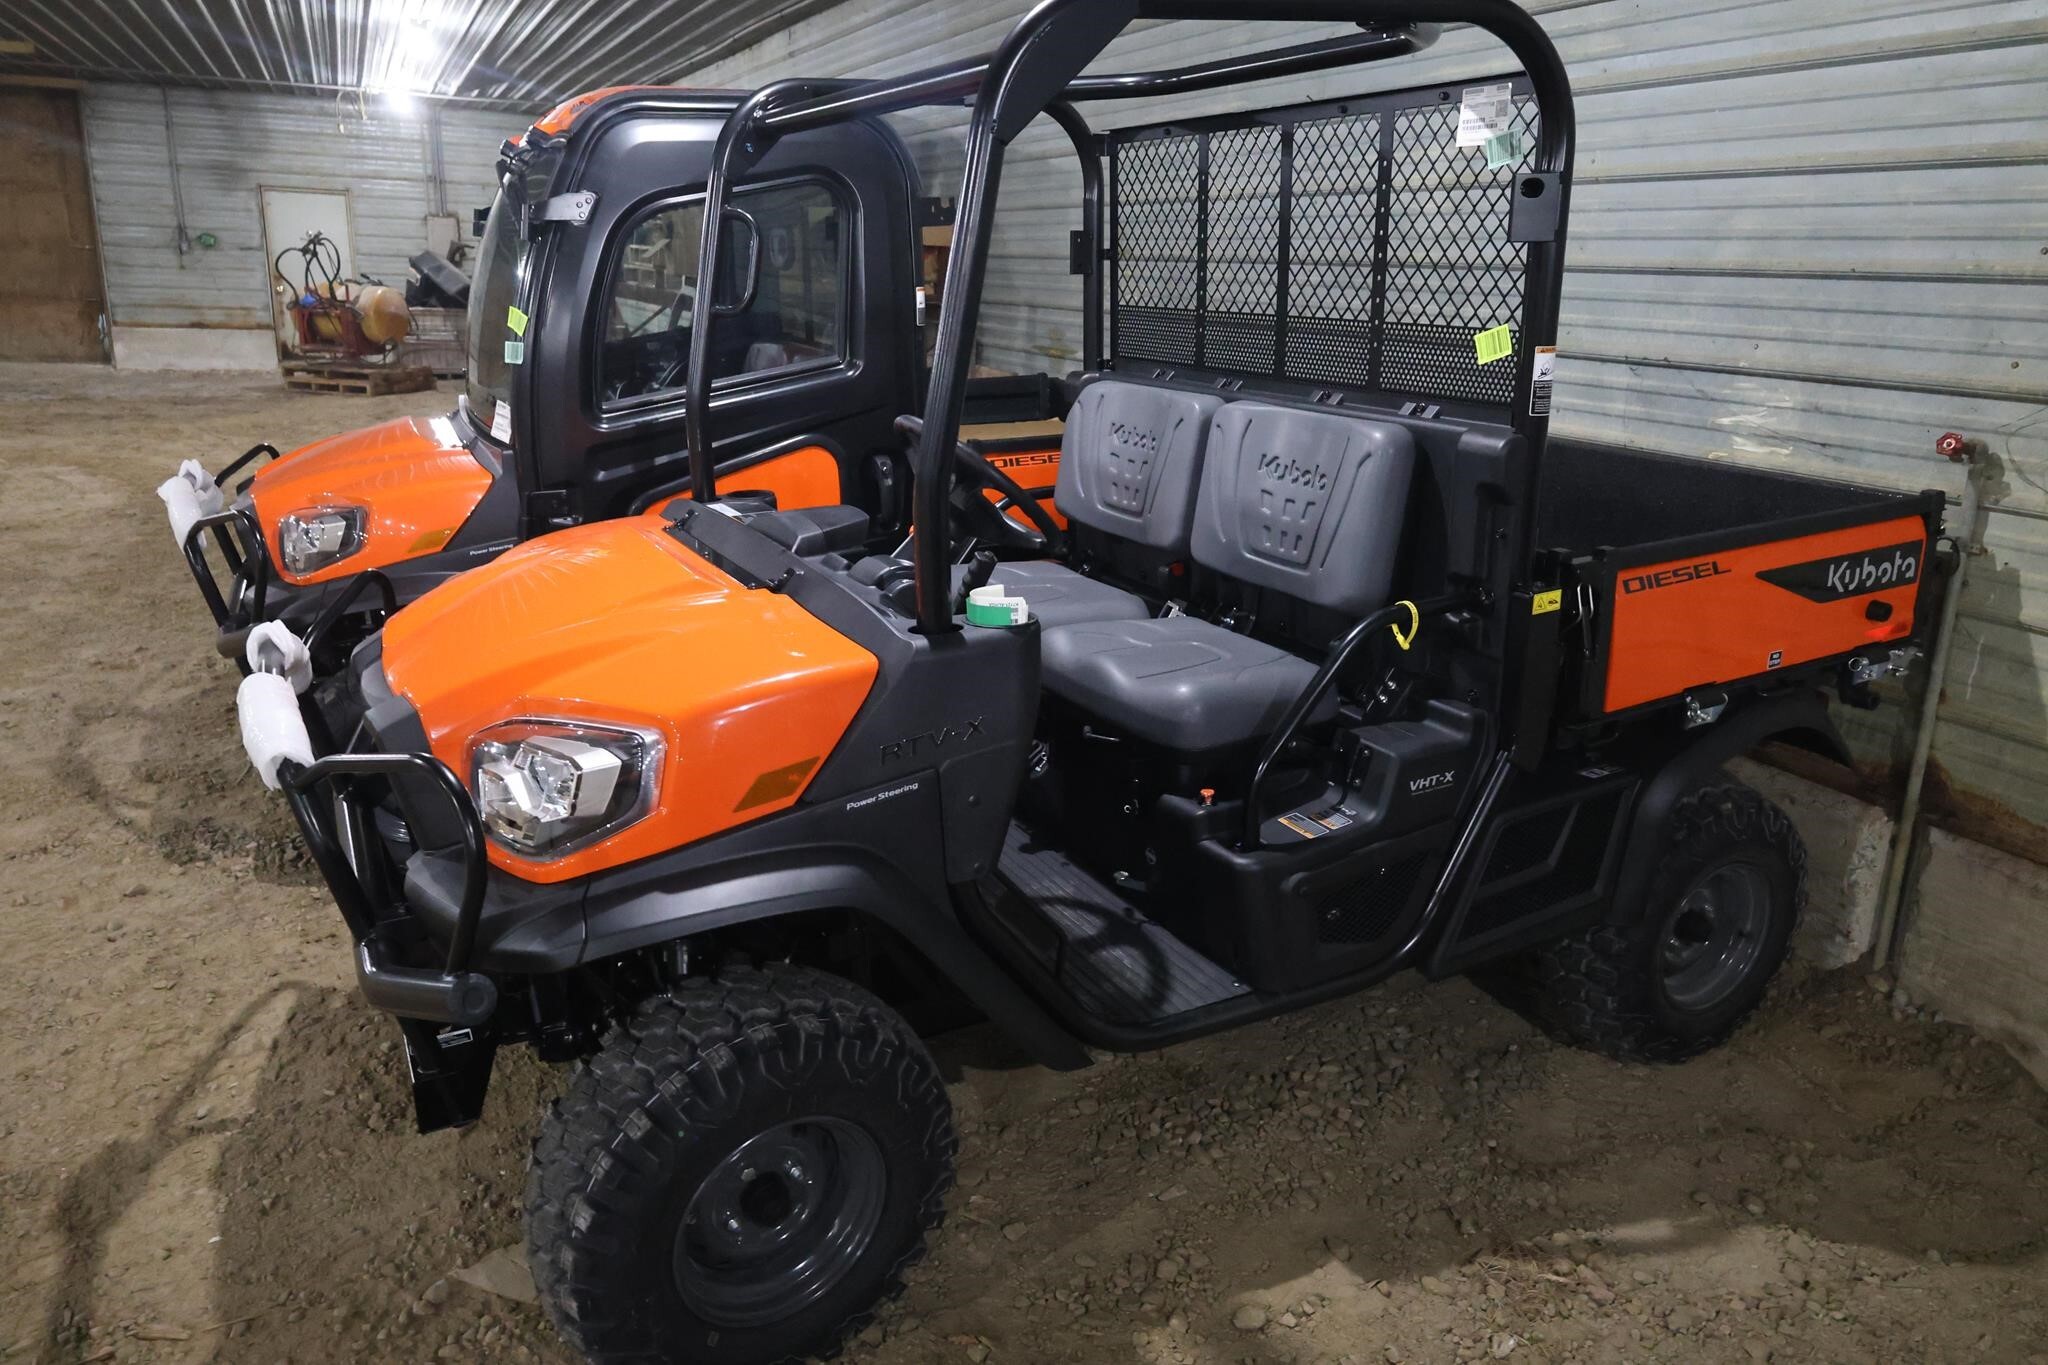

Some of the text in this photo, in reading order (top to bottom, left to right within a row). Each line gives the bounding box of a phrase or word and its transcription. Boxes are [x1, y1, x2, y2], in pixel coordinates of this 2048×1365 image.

[1258, 453, 1327, 491] Kubota
[1622, 561, 1732, 594] DIESEL
[1827, 550, 1917, 593] Kubota
[846, 782, 919, 811] Power Steering
[1410, 770, 1455, 791] VHT-X
